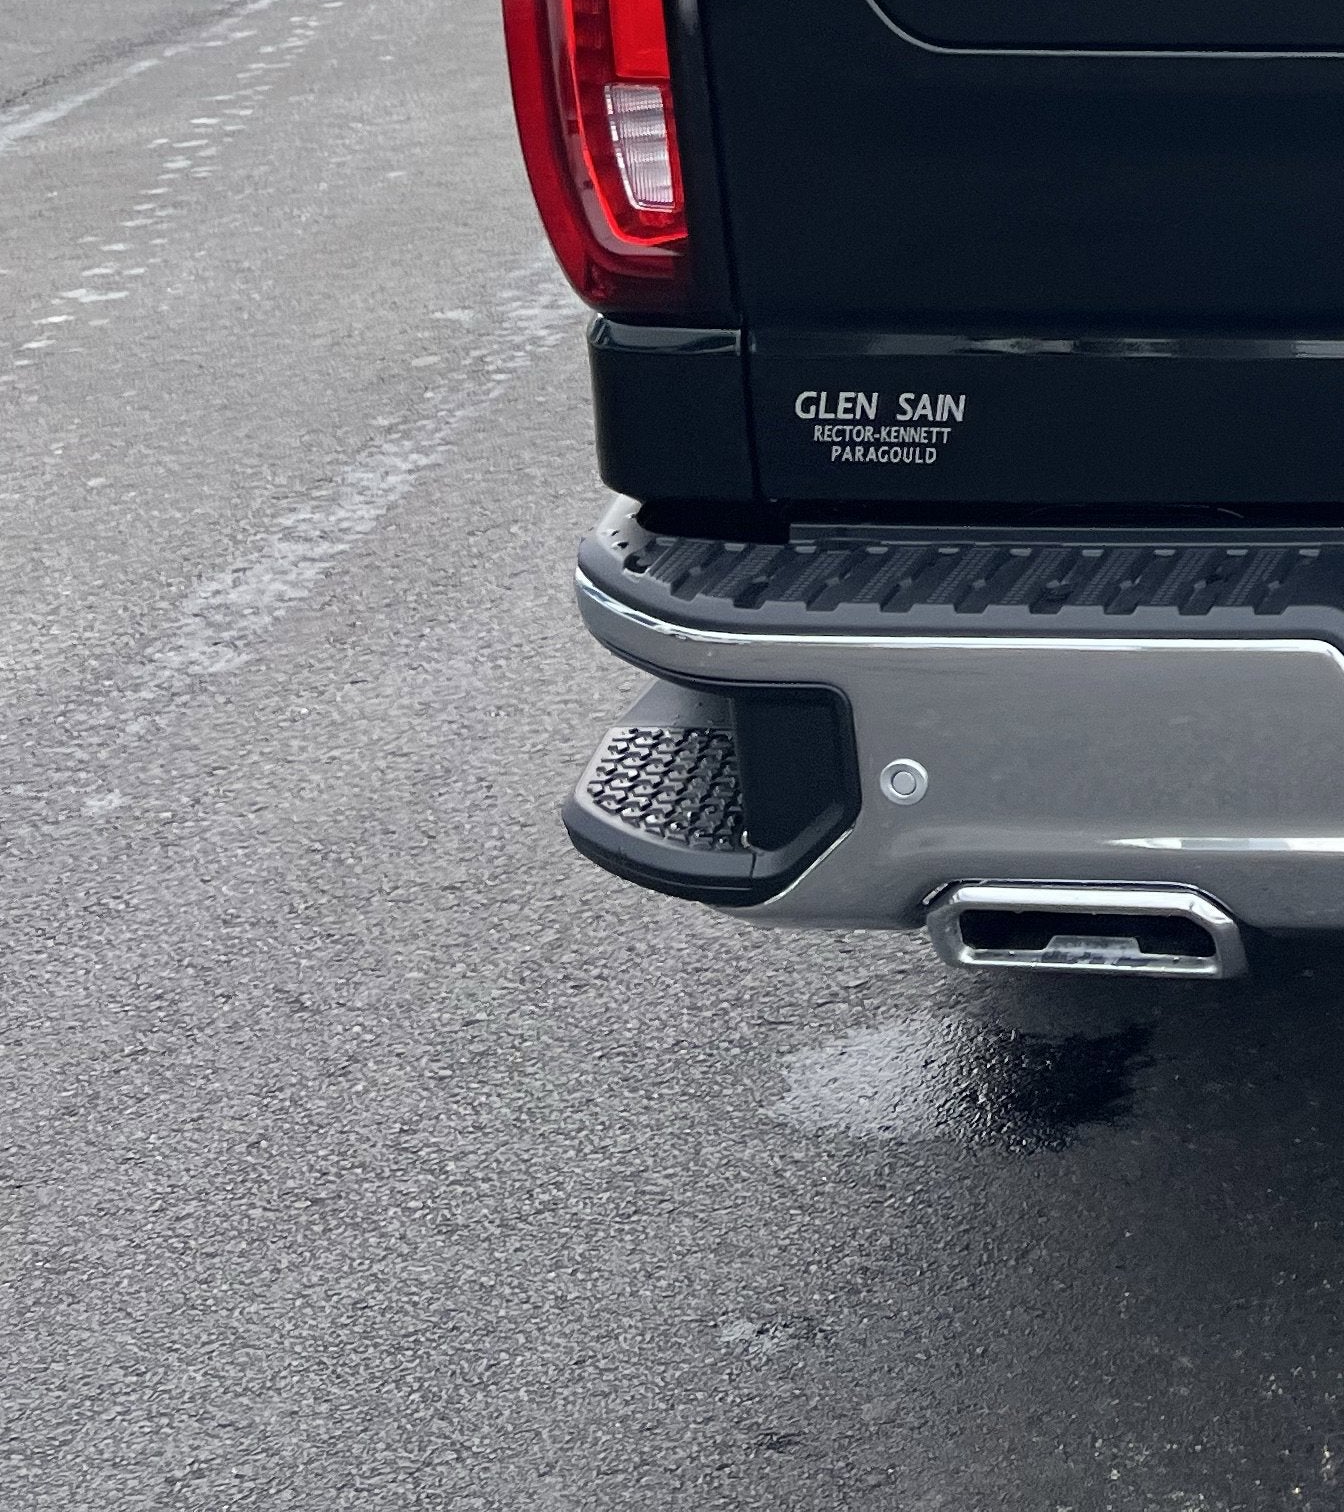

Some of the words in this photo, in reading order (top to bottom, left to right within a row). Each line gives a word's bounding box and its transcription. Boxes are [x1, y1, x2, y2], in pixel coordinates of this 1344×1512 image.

[795, 391, 879, 419] GLEN
[896, 392, 966, 422] SAIN
[813, 424, 952, 444] RECTOR-KENNETT
[831, 445, 937, 464] PARAGOULD
